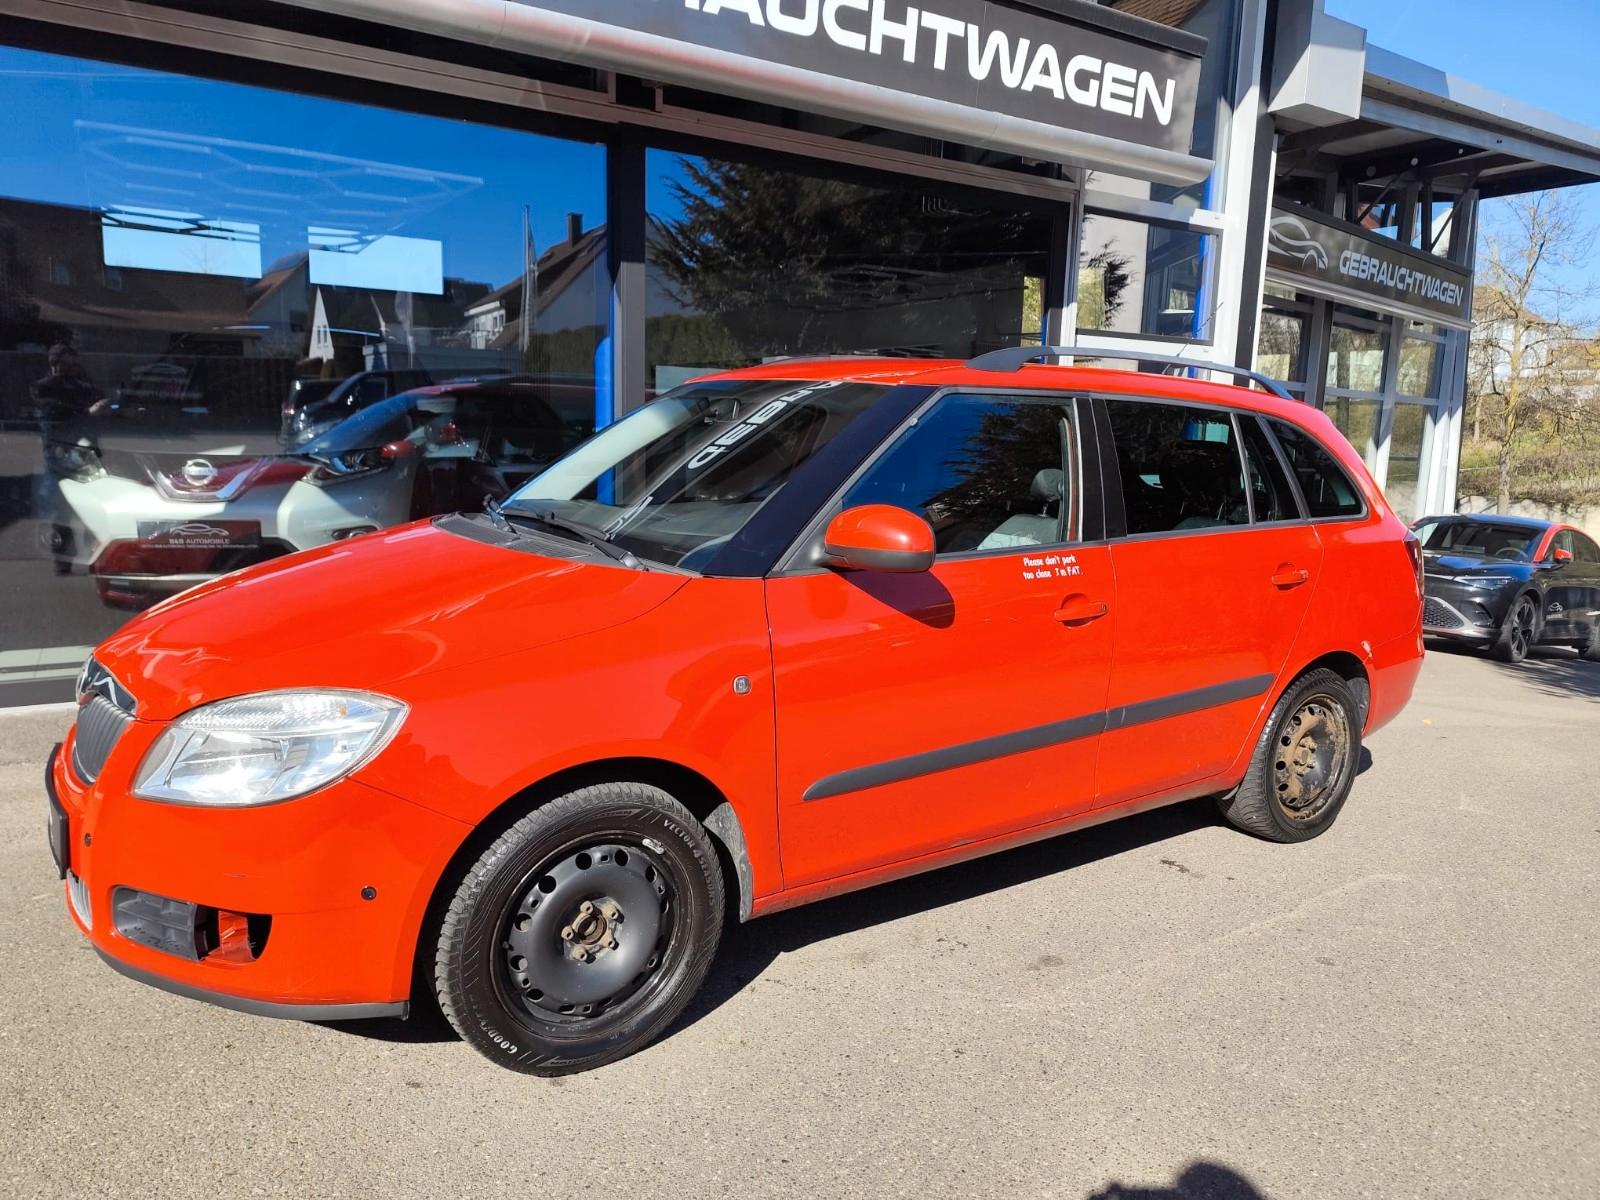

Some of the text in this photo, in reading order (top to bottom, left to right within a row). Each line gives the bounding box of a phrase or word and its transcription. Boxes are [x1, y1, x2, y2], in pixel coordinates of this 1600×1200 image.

[685, 0, 1175, 126] UCHTWAGEN
[1339, 250, 1464, 307] GEBRAUCHTWAGEN
[1023, 554, 1076, 567] Please don't park
[663, 819, 697, 849] VECTOR
